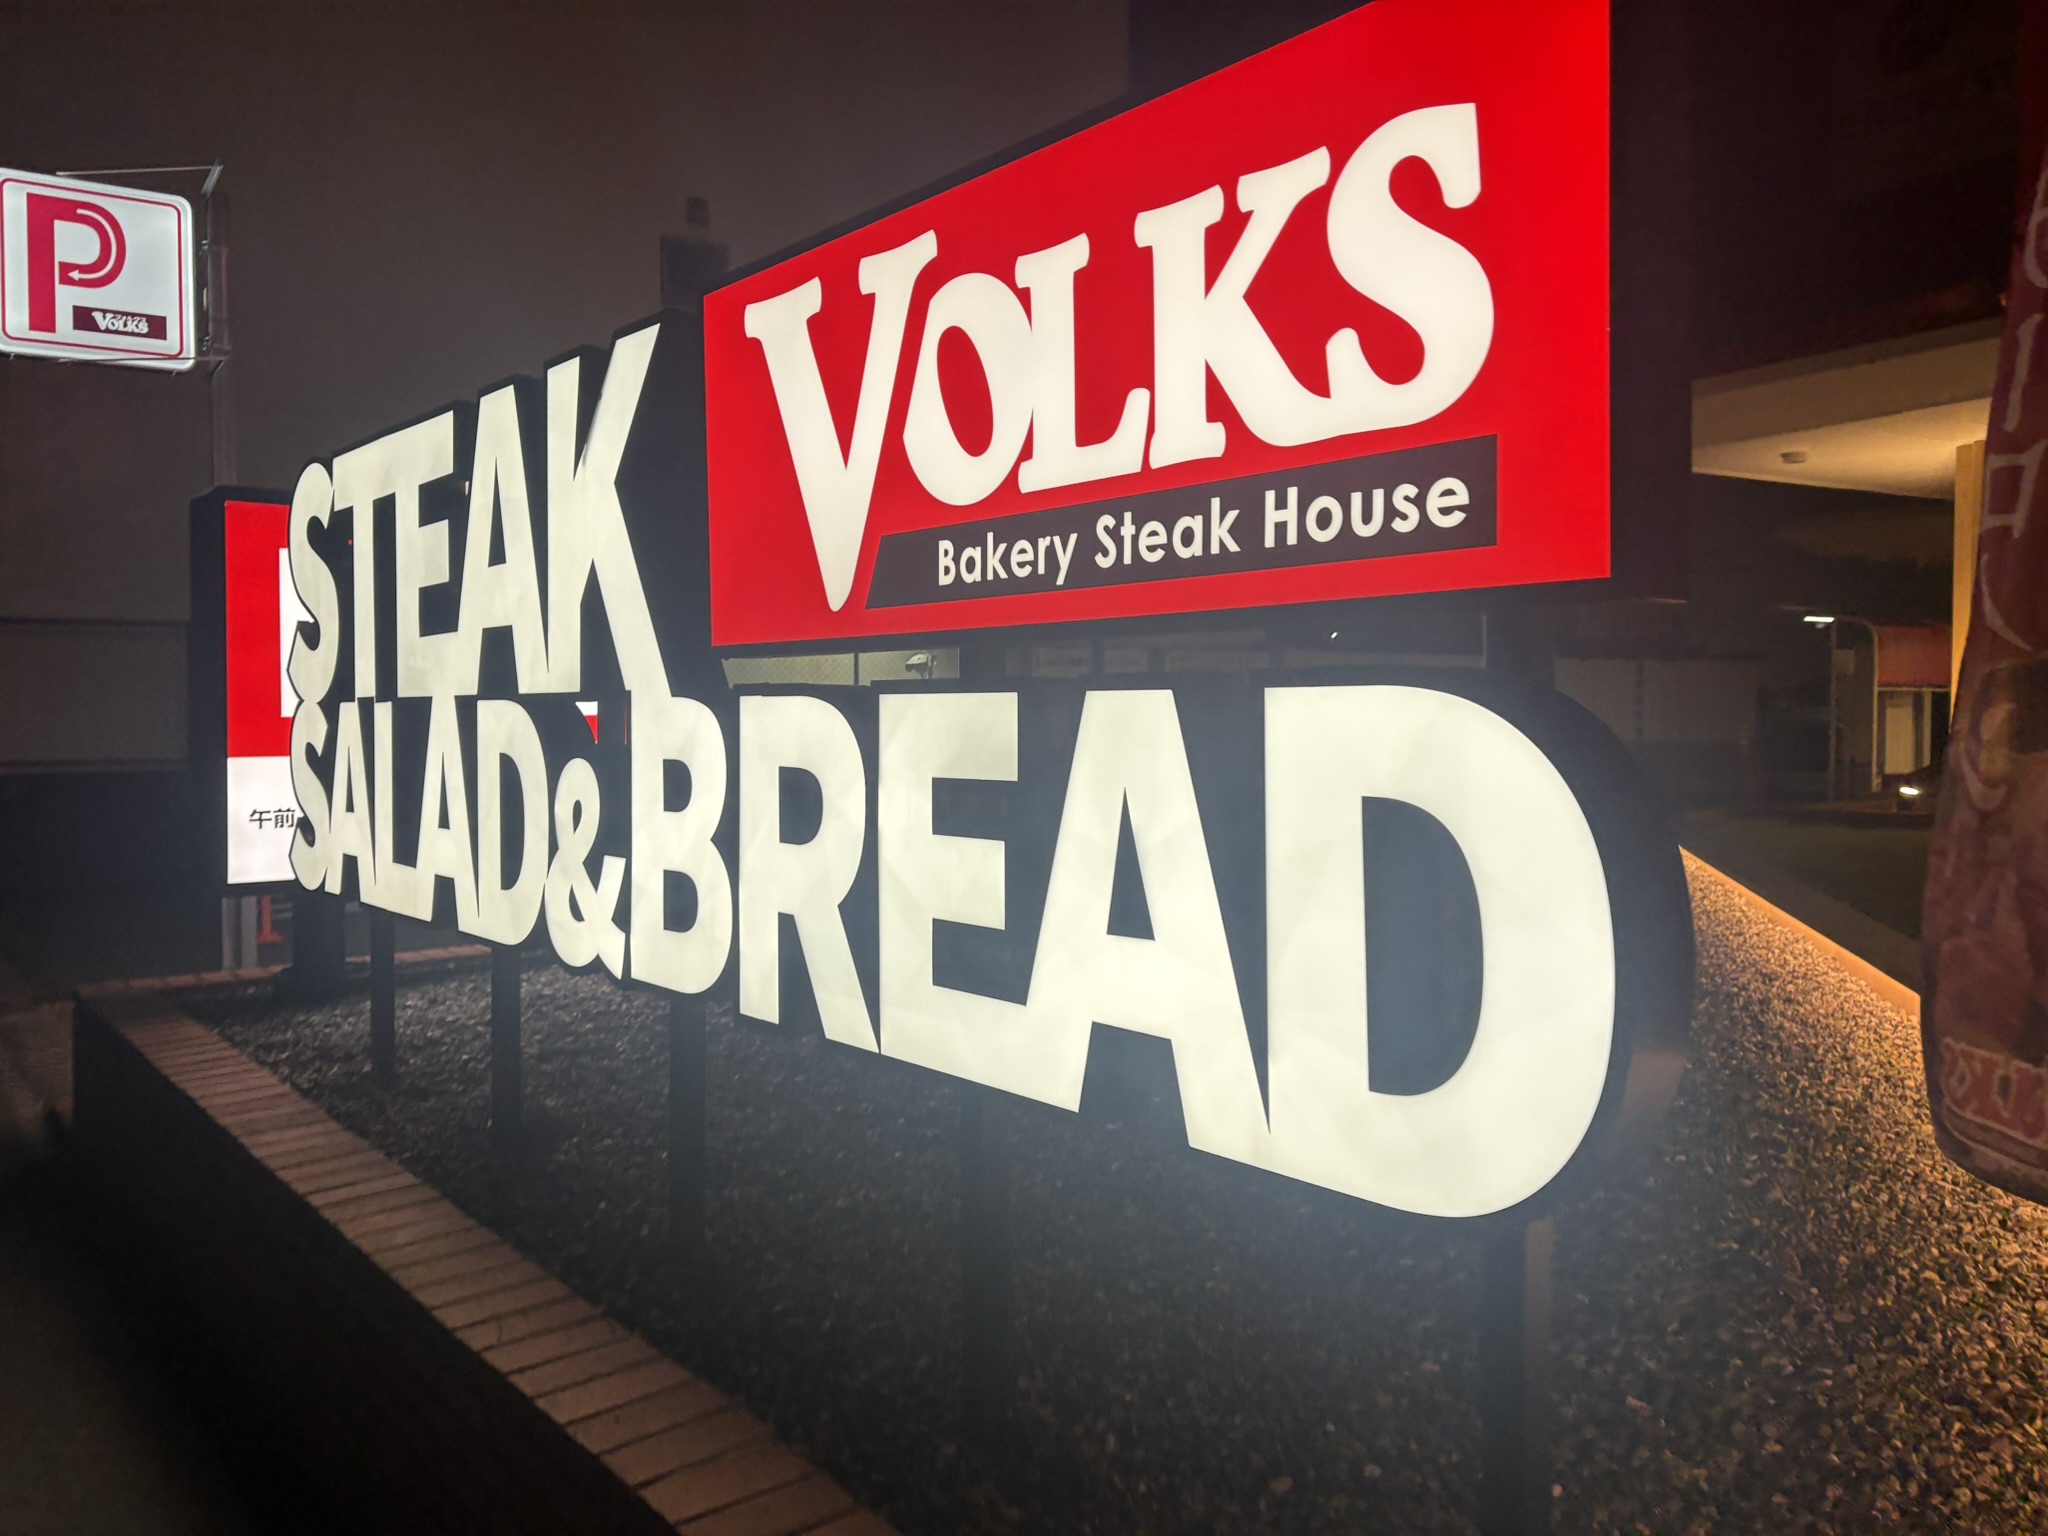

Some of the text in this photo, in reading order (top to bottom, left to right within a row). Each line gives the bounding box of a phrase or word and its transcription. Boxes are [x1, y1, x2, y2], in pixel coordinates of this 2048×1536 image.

[26, 192, 127, 333] P
[91, 311, 149, 334] VOLKS
[744, 102, 1495, 612] VOLKS
[289, 323, 672, 704] STEAK
[937, 476, 1470, 586] Bakery Steak House
[249, 807, 296, 830] 午前
